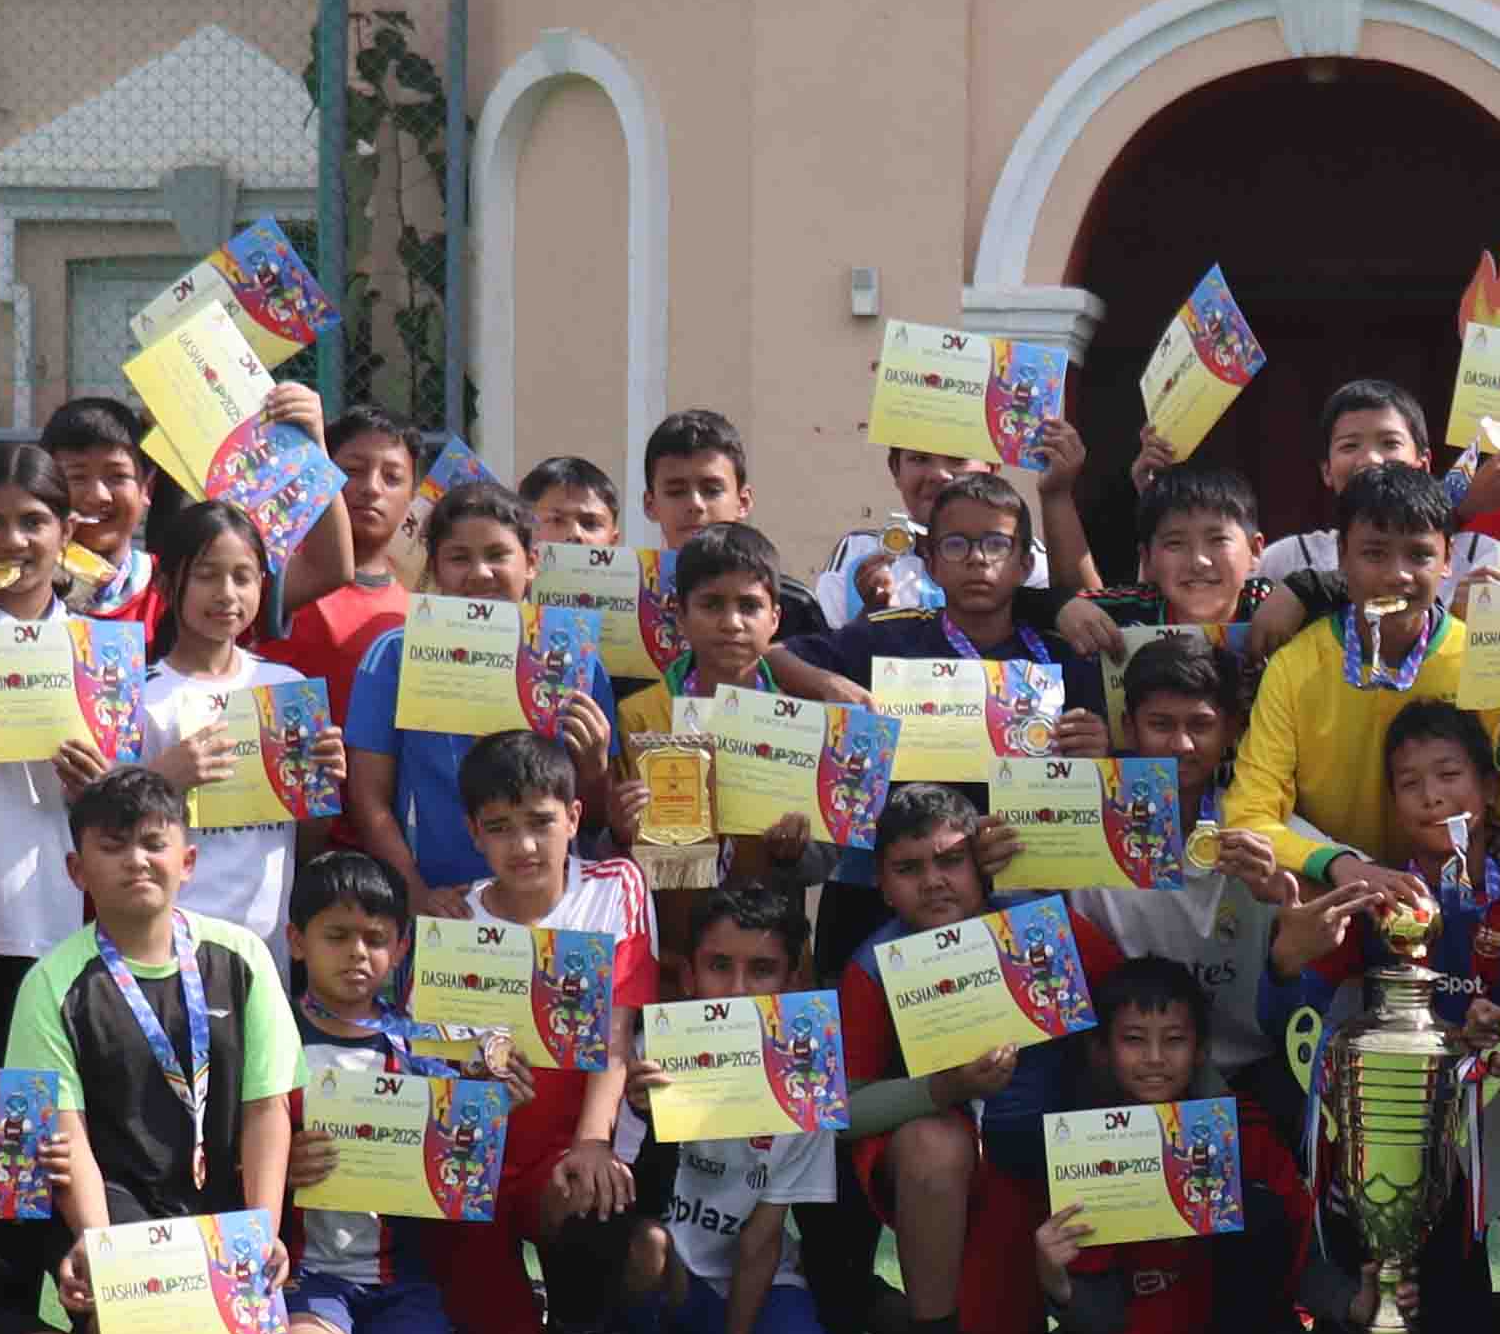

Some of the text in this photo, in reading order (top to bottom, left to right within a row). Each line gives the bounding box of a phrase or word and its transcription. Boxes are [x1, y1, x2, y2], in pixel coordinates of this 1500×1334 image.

[942, 334, 968, 351] DAV
[885, 370, 984, 397] DASHAIN UP-2025
[590, 549, 615, 567] DAV
[581, 592, 636, 612] UP-2025
[468, 603, 495, 621] DAV
[14, 626, 41, 643] DAV
[409, 646, 514, 668] DASHAIN UP-2025
[932, 663, 957, 677] DAV
[9, 673, 72, 690] UP-2025
[774, 701, 802, 718] DAV
[924, 701, 982, 716] UP-2025
[758, 743, 816, 767] UP-2025
[1047, 762, 1072, 779] DAV
[997, 808, 1100, 824] DASHAIN UP-2025
[477, 927, 505, 945] DAV
[935, 928, 961, 949] DAV
[421, 970, 529, 995] DASHAIN UP-2025
[897, 969, 1000, 1008] DASHAIN UP-2025
[705, 1004, 730, 1021] DAV
[700, 1051, 761, 1067] UP-2025
[375, 1077, 404, 1095] DAV
[1105, 1111, 1131, 1129] DAV
[360, 1123, 422, 1145] UP-2025
[1055, 1158, 1161, 1180] DASHAIN UP-2025
[148, 1224, 173, 1244] DAV
[101, 1274, 208, 1301] DASHAIN UP-2025
